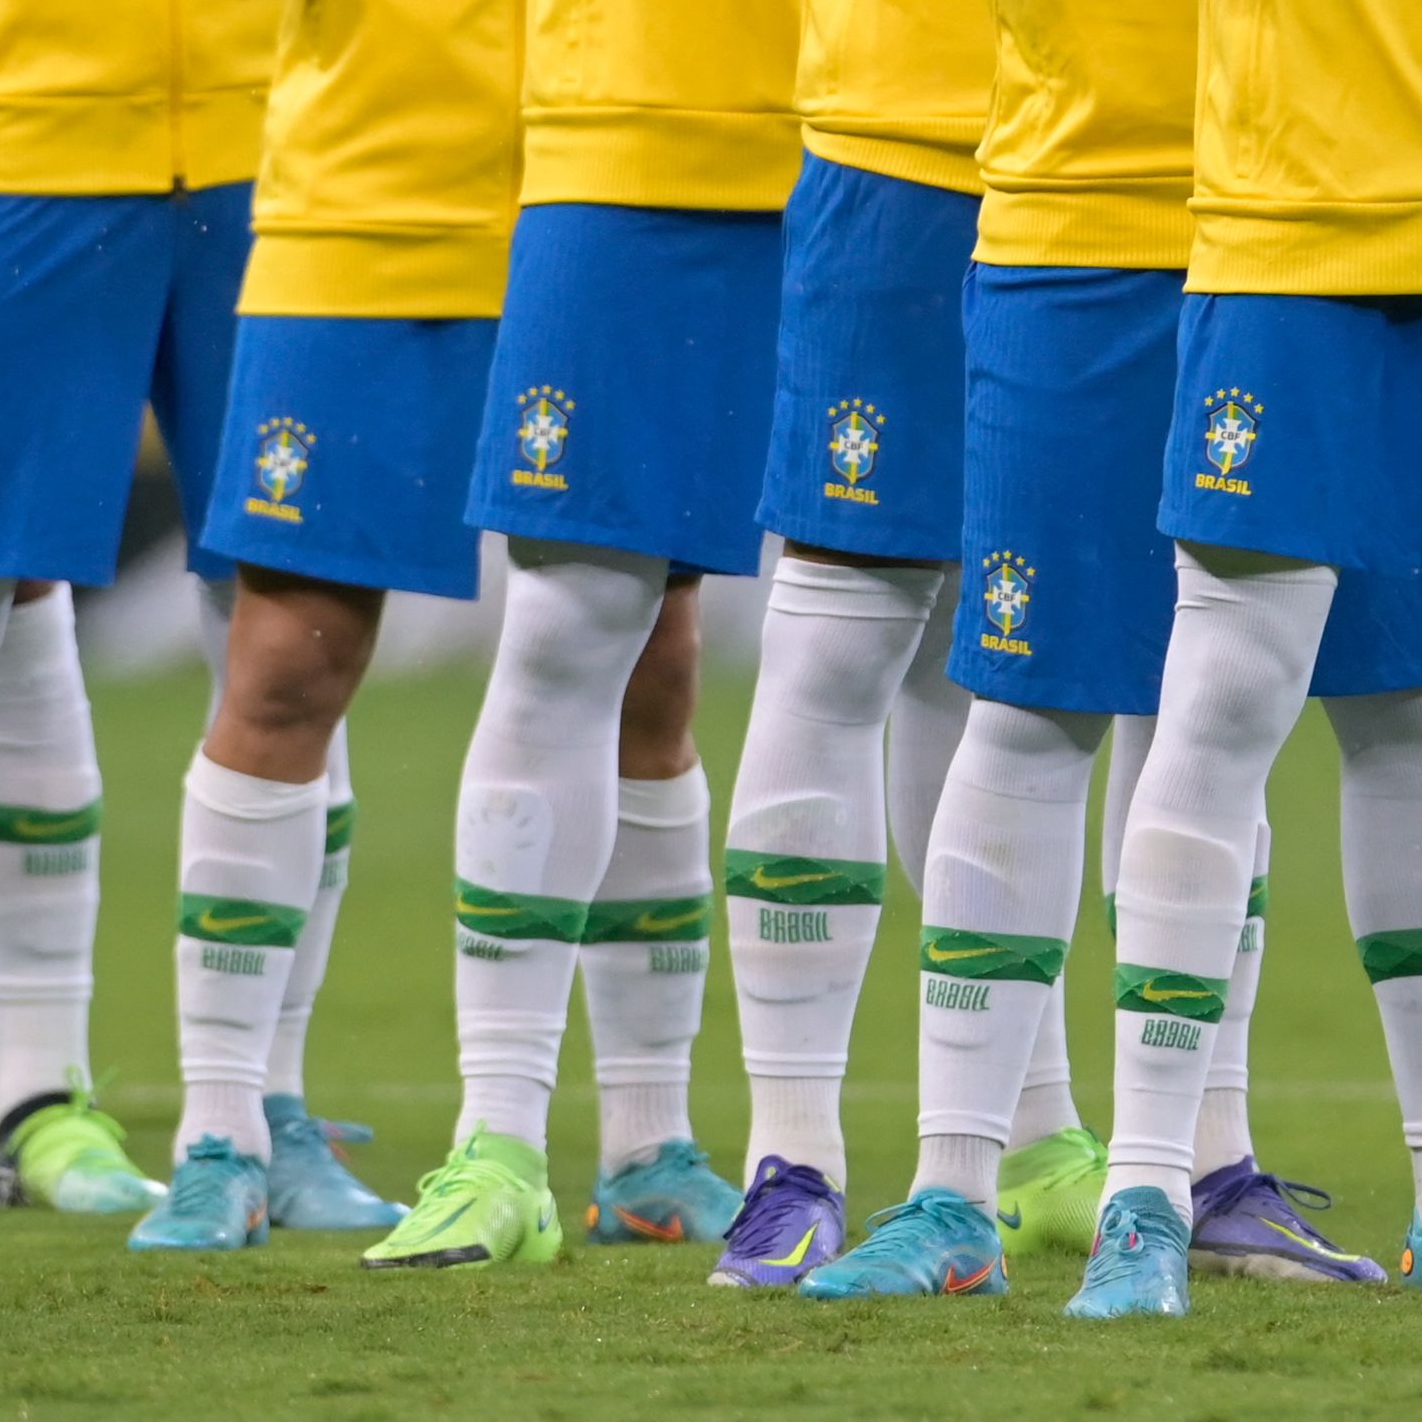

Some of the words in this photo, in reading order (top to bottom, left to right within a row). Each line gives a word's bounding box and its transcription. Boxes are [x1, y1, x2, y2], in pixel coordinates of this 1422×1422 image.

[824, 482, 880, 506] BRASIL
[1194, 473, 1252, 496] BRASIL
[980, 632, 1033, 657] BRASIL
[759, 907, 834, 944] BRASIL
[925, 978, 991, 1012] BRASIL
[1140, 1018, 1203, 1052] BRASIL
